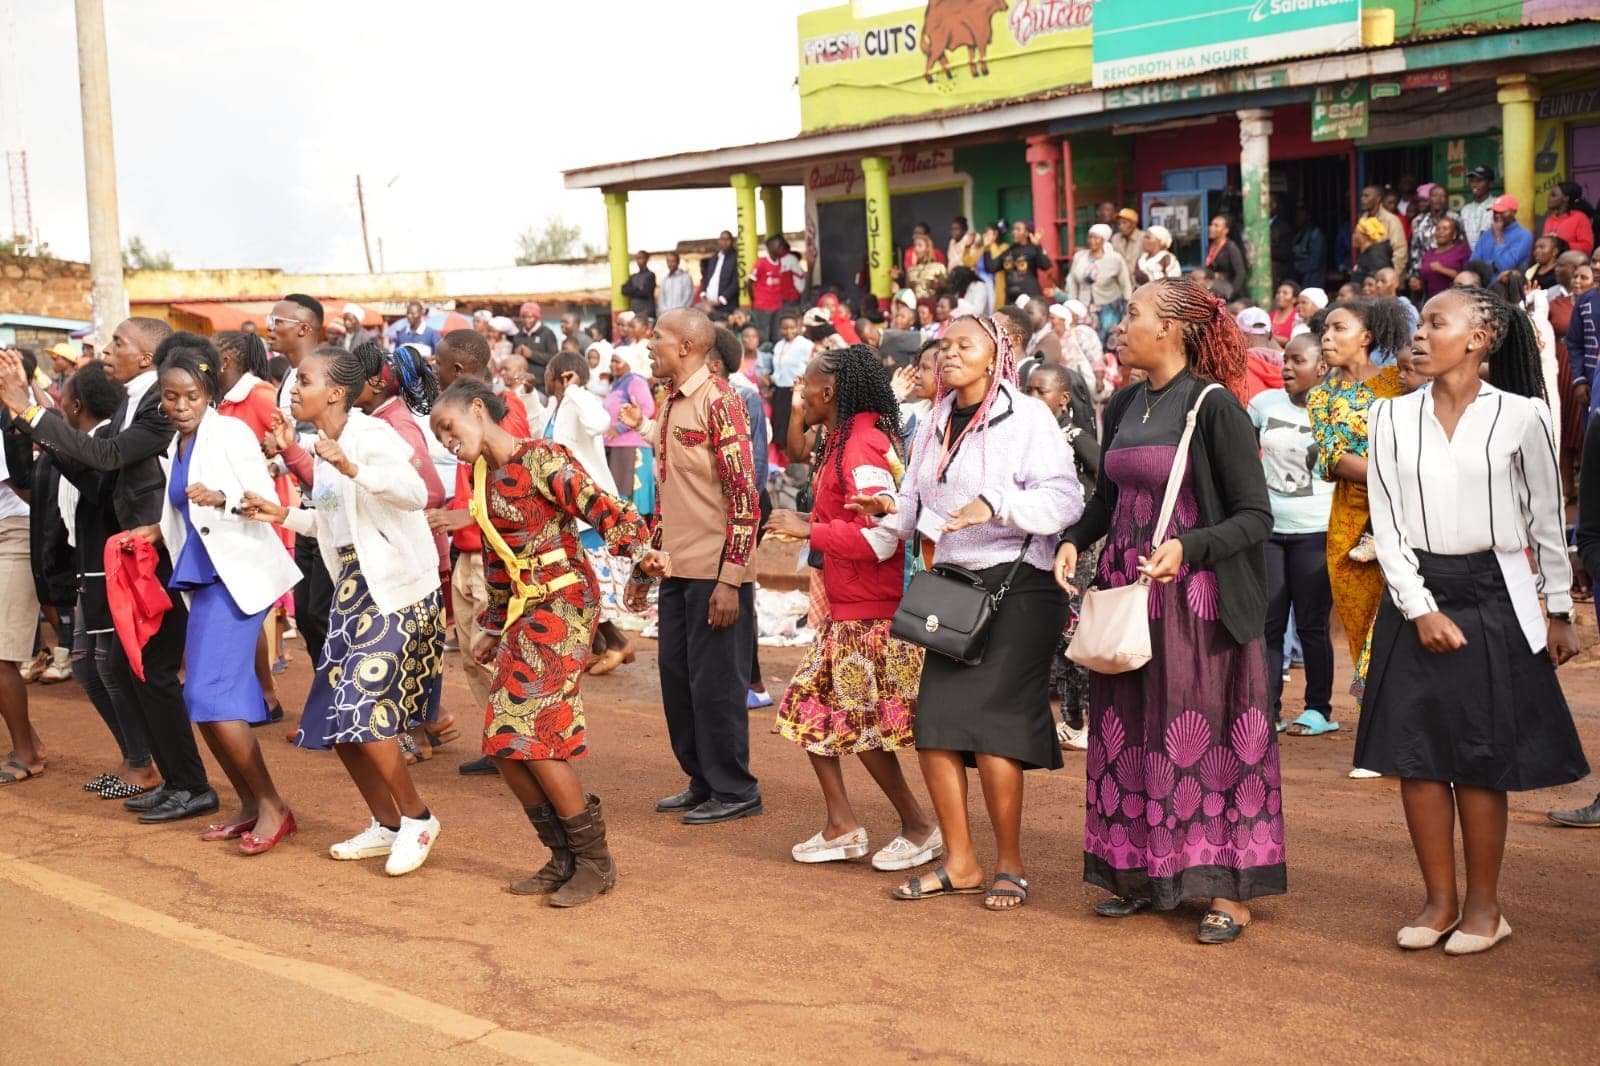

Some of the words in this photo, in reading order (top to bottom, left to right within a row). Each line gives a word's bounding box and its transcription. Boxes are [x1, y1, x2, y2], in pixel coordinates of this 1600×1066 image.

[864, 24, 916, 56] CUTS
[1103, 62, 1172, 81] REHOBOTH
[1177, 57, 1195, 70] HA
[1200, 48, 1249, 65] NGURE
[868, 198, 880, 269] CUTS
